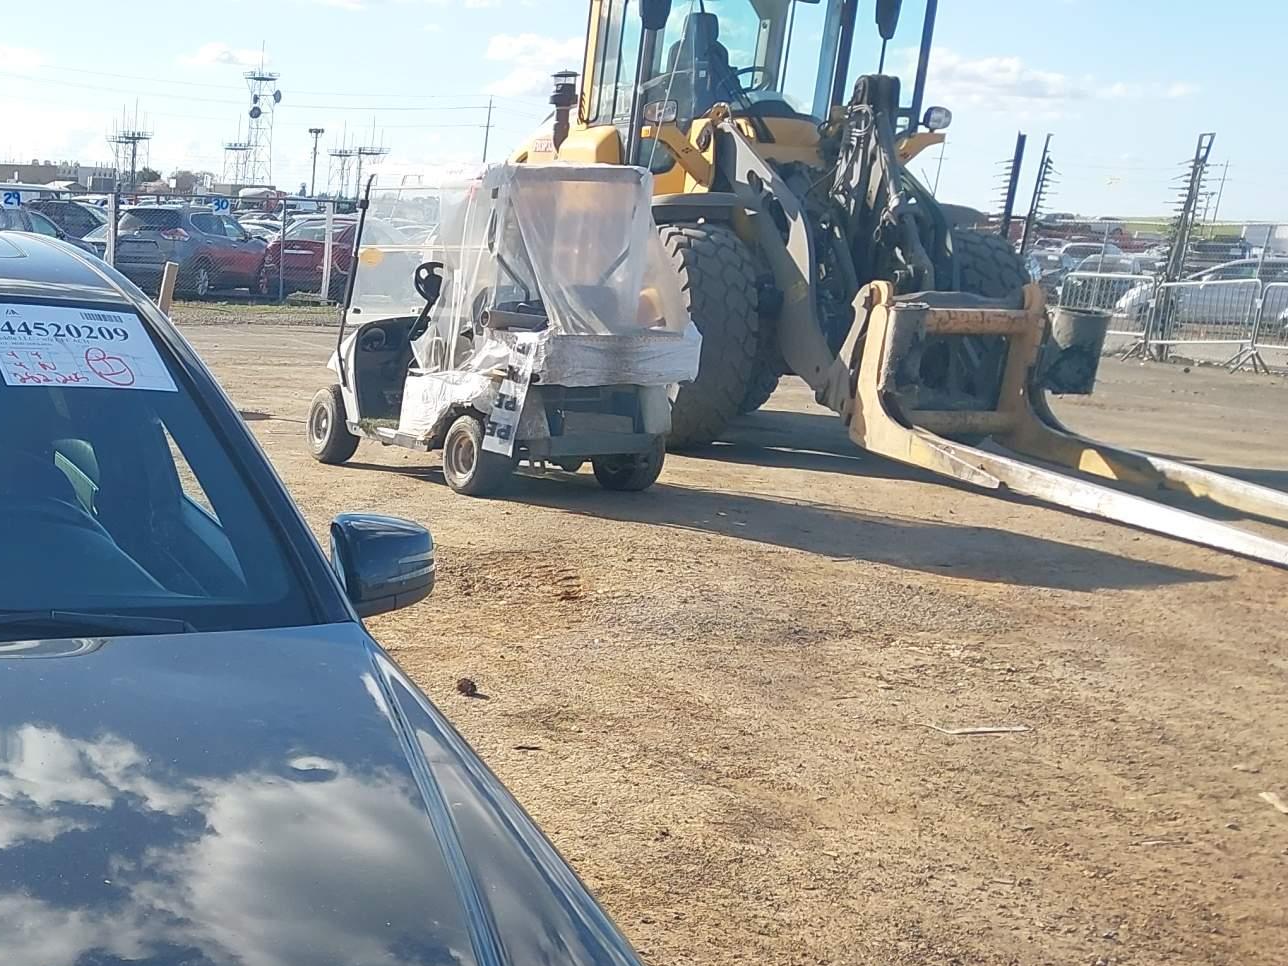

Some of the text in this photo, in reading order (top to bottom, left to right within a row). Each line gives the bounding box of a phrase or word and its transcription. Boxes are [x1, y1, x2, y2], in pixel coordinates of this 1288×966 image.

[4, 191, 20, 206] 29
[213, 198, 229, 211] 30
[0, 320, 129, 342] 44520209
